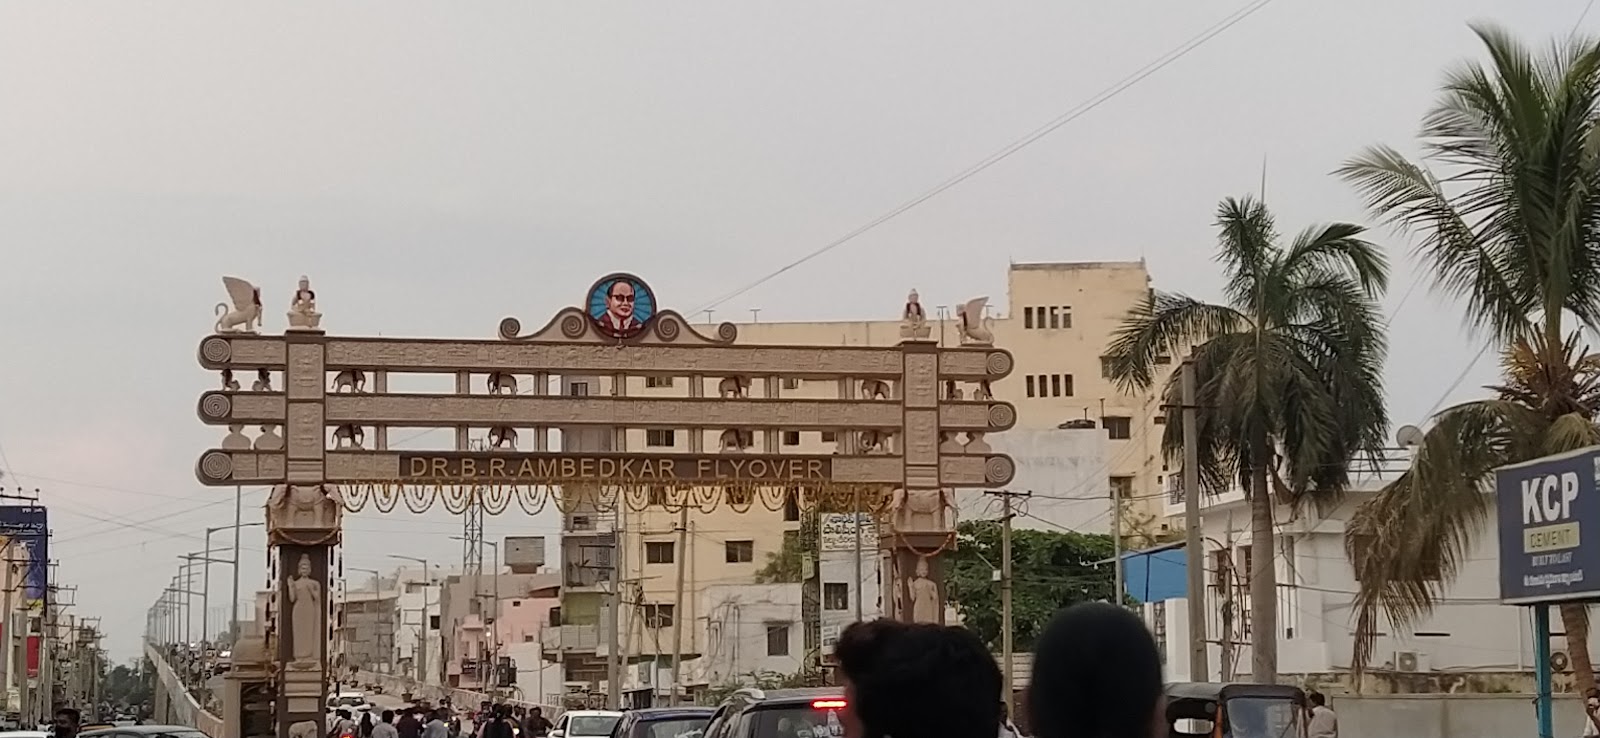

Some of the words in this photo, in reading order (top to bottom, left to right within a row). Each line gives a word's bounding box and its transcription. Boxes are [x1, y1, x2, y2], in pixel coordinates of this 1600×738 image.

[697, 459, 824, 479] FLYOVER
[1521, 471, 1579, 525] KCP
[1530, 529, 1571, 548] CEMENT
